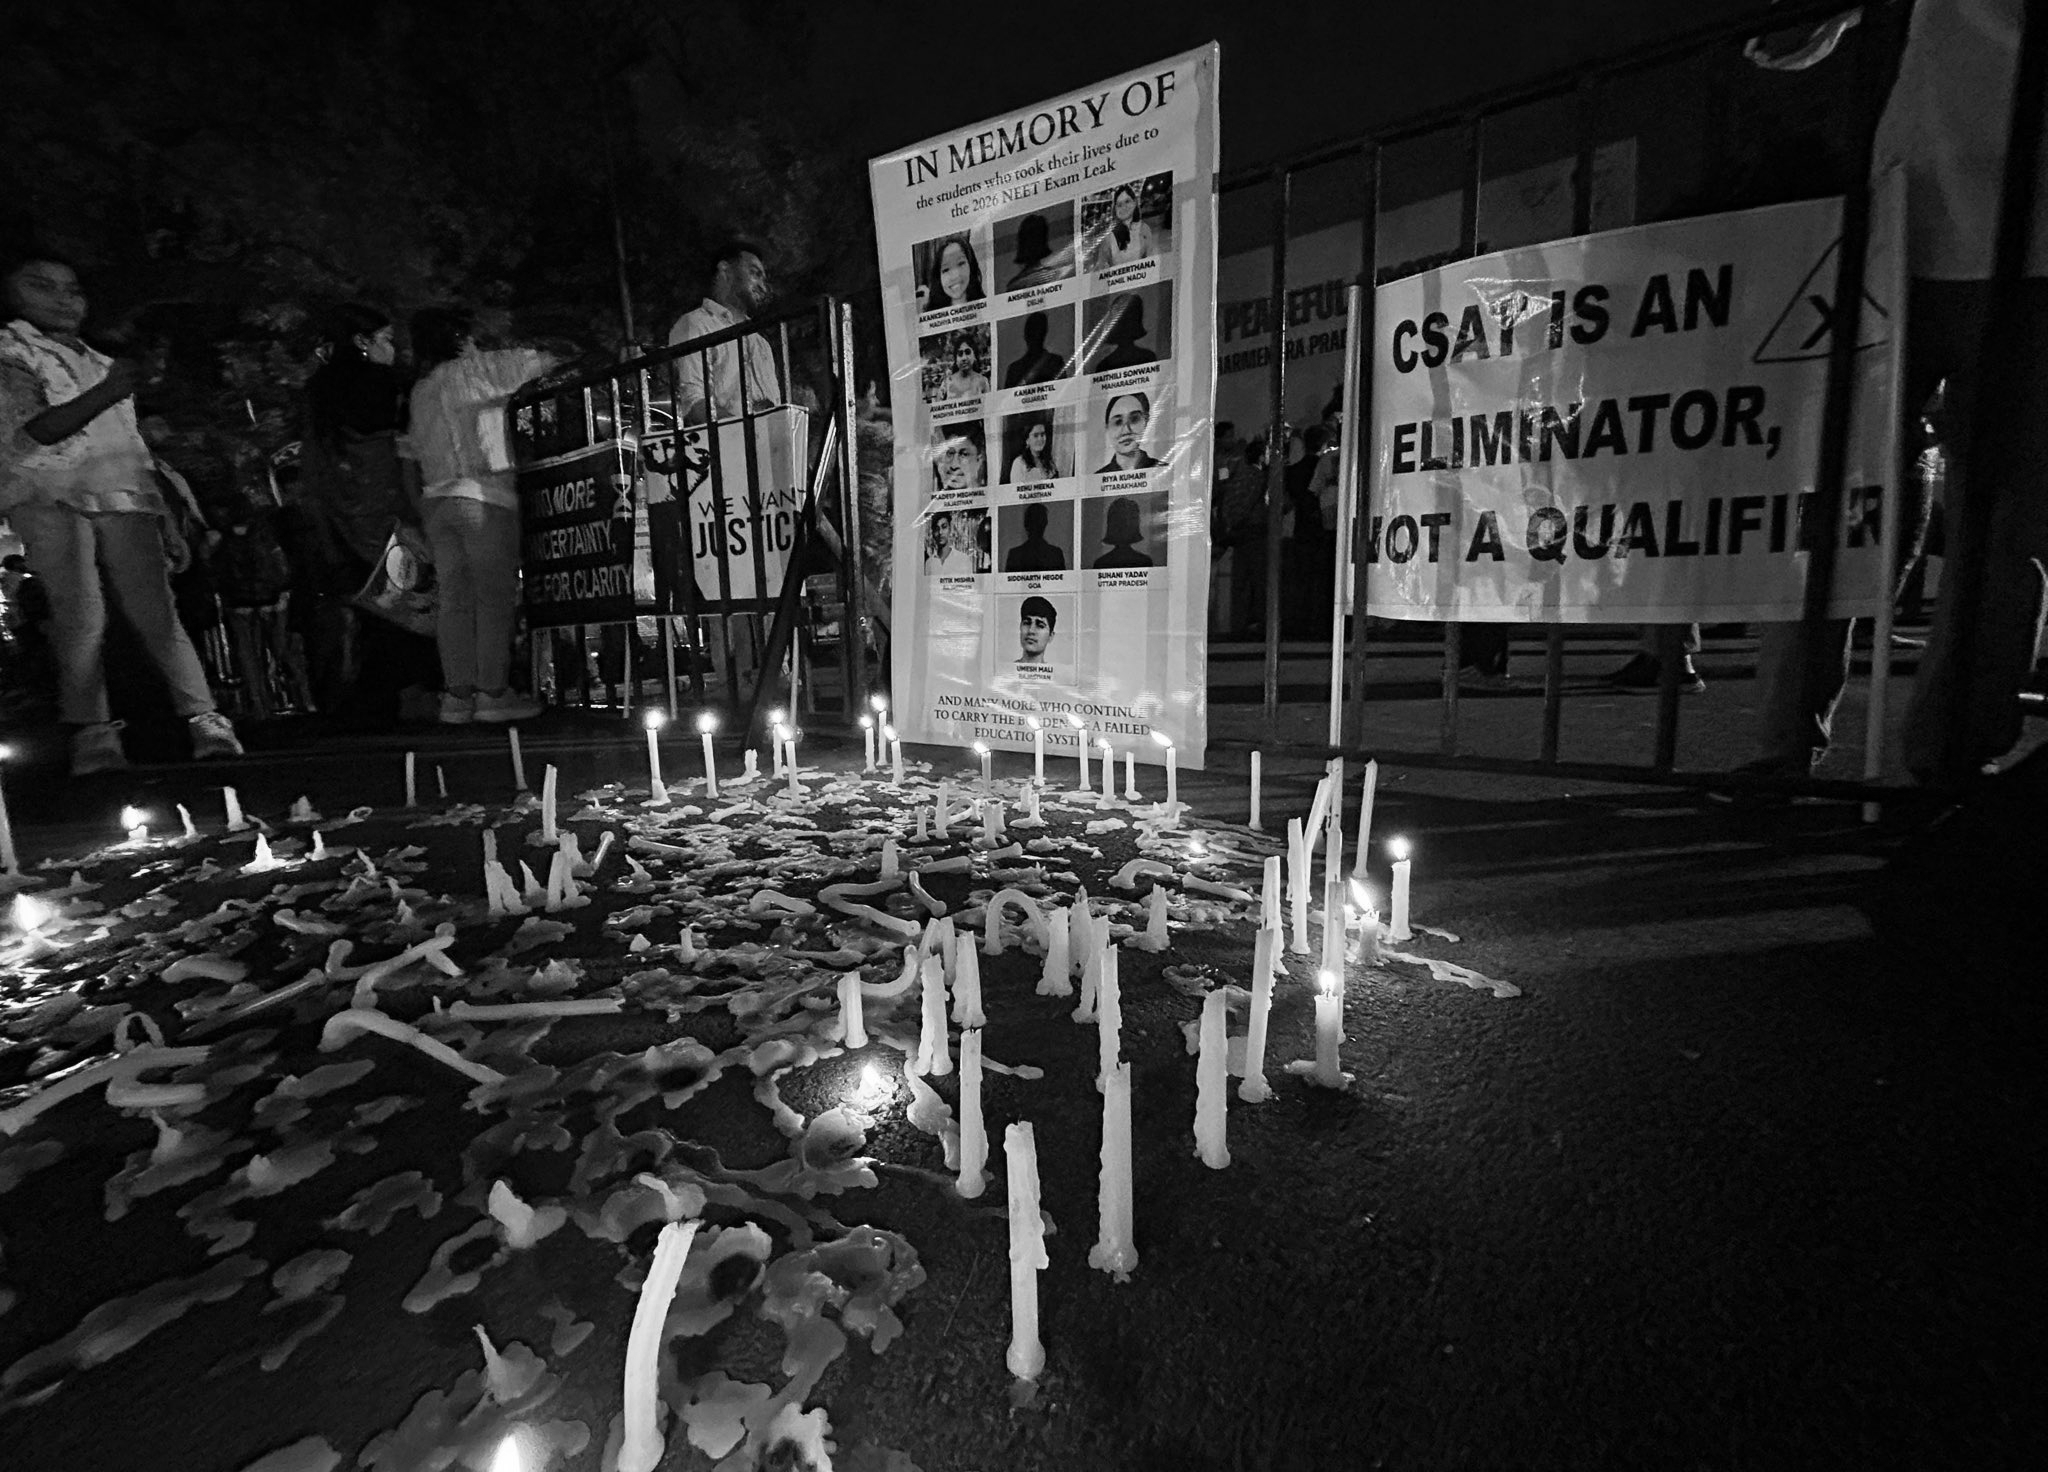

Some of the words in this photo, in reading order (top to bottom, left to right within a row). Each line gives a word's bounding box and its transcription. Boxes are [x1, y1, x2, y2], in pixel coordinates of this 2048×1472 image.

[904, 150, 938, 186] IN
[949, 92, 1110, 173] MEMORY
[1122, 70, 1176, 116] OF
[916, 195, 934, 210] the
[936, 180, 982, 205] students
[984, 171, 1012, 188] who
[1015, 161, 1045, 180] took
[1048, 152, 1079, 170] their
[1082, 142, 1112, 161] lives
[1115, 132, 1140, 149] due
[1144, 127, 1159, 141] to
[951, 204, 970, 218] the
[973, 194, 1000, 212] 2026
[1002, 181, 1041, 204] NEET
[1044, 172, 1080, 192] Exam
[1083, 158, 1117, 179] Leak
[1098, 259, 1156, 281] ANUKEERTHANA
[1106, 275, 1125, 287] TAMIL
[1126, 271, 1147, 283] NADU
[1007, 291, 1035, 303] ANSHIKA
[1036, 284, 1063, 297] PANDEY
[1026, 297, 1045, 307] DELHI
[1548, 284, 1611, 350] IS
[1630, 264, 1733, 339] AN
[919, 310, 949, 323] AKANKSHA
[949, 301, 987, 316] CHATURVEDI
[1224, 279, 1348, 344] PEAEFUL
[929, 318, 951, 328] MADHYA
[952, 313, 977, 323] PRADESH
[1093, 373, 1122, 384] MAITHILI
[1101, 376, 1150, 390] MAHARASHTRA
[1036, 384, 1056, 395] PATEL
[929, 402, 957, 413] AVANTIKA
[1021, 394, 1049, 405] GUJARAT
[932, 410, 954, 420] MADHYA
[954, 407, 979, 416] PRADESH
[1391, 385, 1782, 475] ELIMINATOR,
[1102, 474, 1118, 484] RIYA
[1119, 471, 1147, 482] KUMARI
[956, 489, 986, 498] MEGHWAL
[1016, 484, 1033, 493] RENU
[1033, 482, 1055, 491] MEENA
[1100, 481, 1148, 492] UTTARAKHAND
[553, 477, 597, 514] MORE
[1018, 491, 1052, 500] RAJASTHAN
[1465, 511, 1505, 563] A
[574, 563, 633, 600] CLARITY
[1124, 571, 1148, 579] YADAV
[1097, 580, 1117, 588] UTTAR
[1118, 579, 1148, 587] PRADESH
[937, 695, 962, 706] AND
[1039, 701, 1071, 713] WHO
[934, 709, 949, 720] TO
[951, 710, 989, 724] CARRY
[990, 713, 1015, 725] THE
[1018, 715, 1068, 729] BDEN
[1092, 721, 1101, 732] A
[1105, 721, 1151, 736] FAILED
[974, 727, 1036, 742] EDUCATIO
[1047, 733, 1099, 748] SYSTM.
